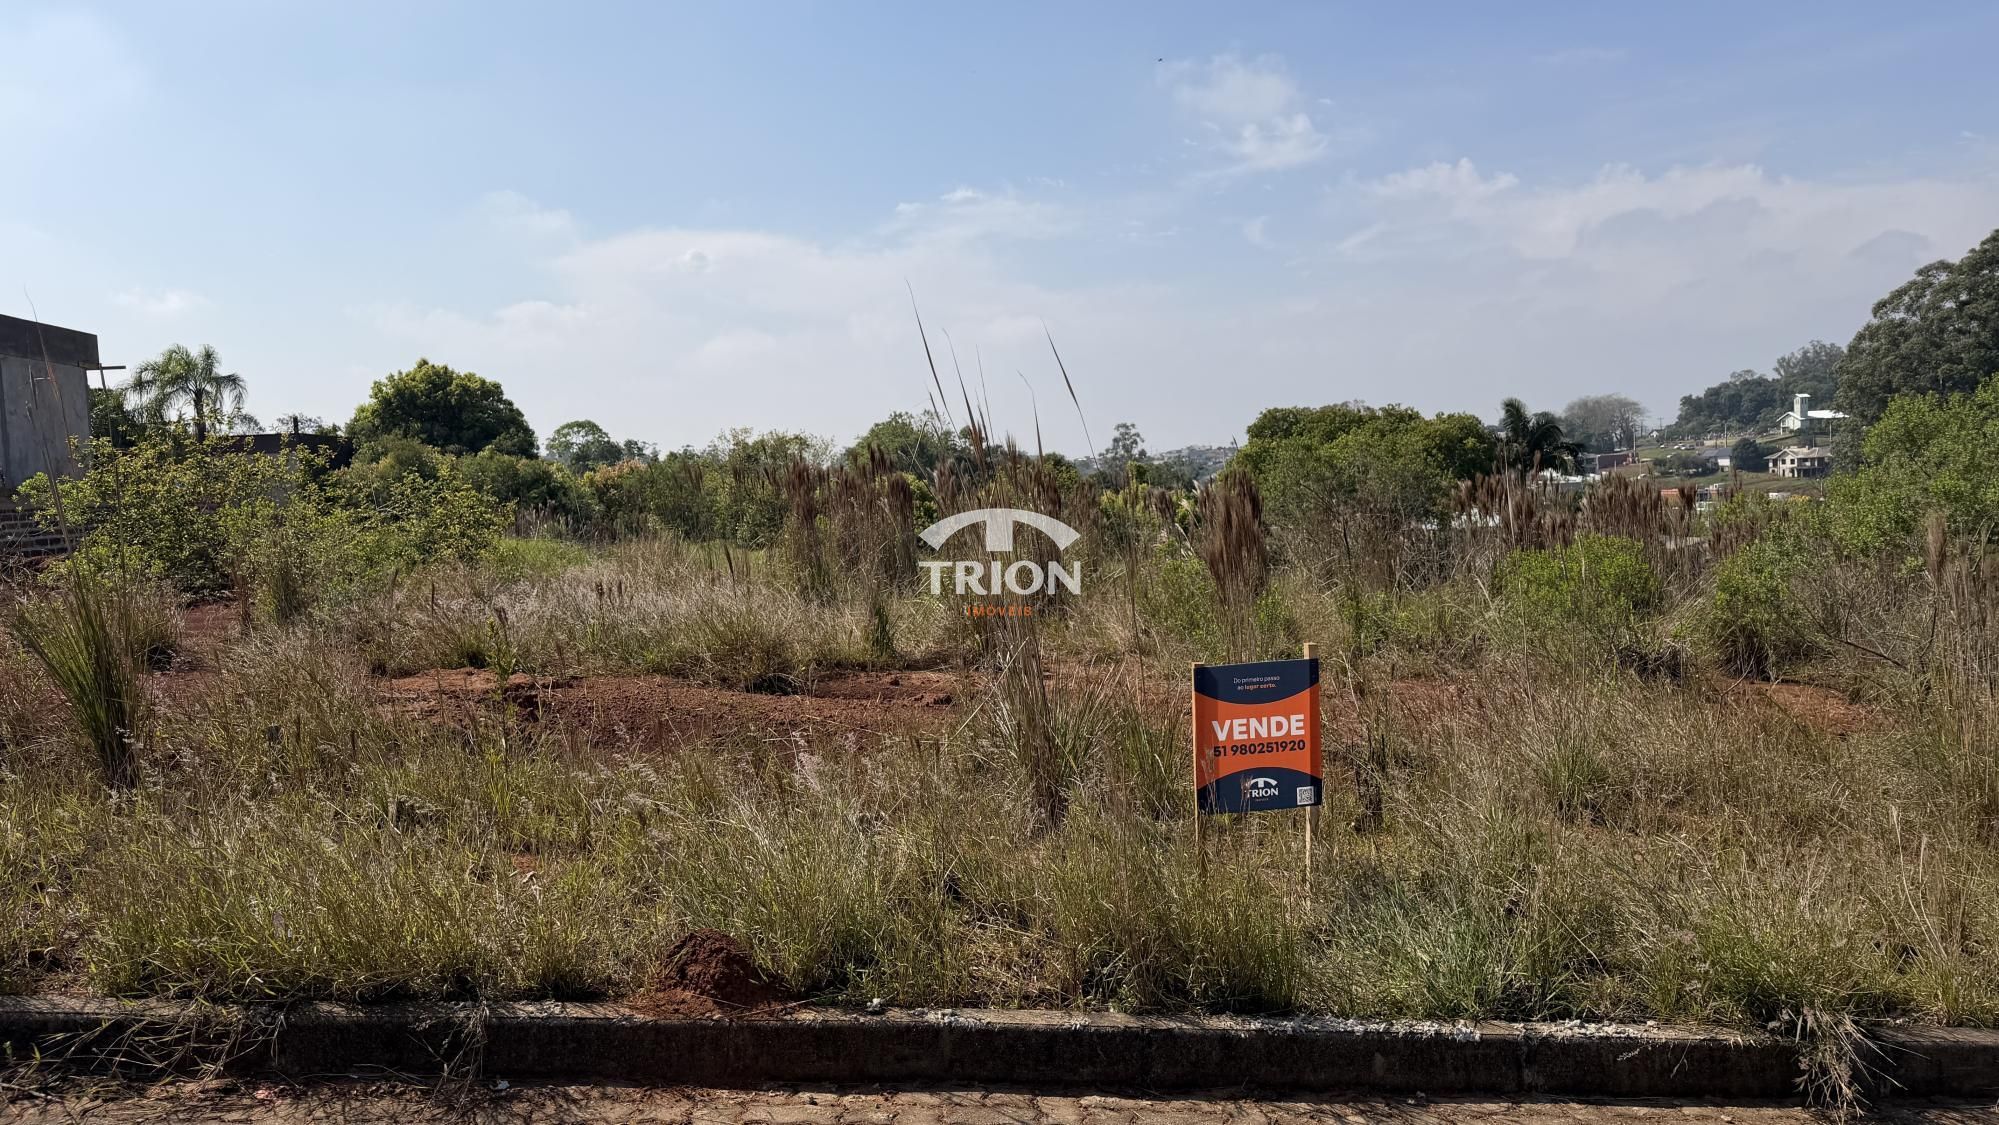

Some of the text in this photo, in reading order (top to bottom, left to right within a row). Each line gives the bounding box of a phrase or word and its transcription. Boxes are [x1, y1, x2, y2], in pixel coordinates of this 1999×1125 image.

[1211, 714, 1305, 742] VENDE
[1213, 739, 1306, 757] 51 980251920
